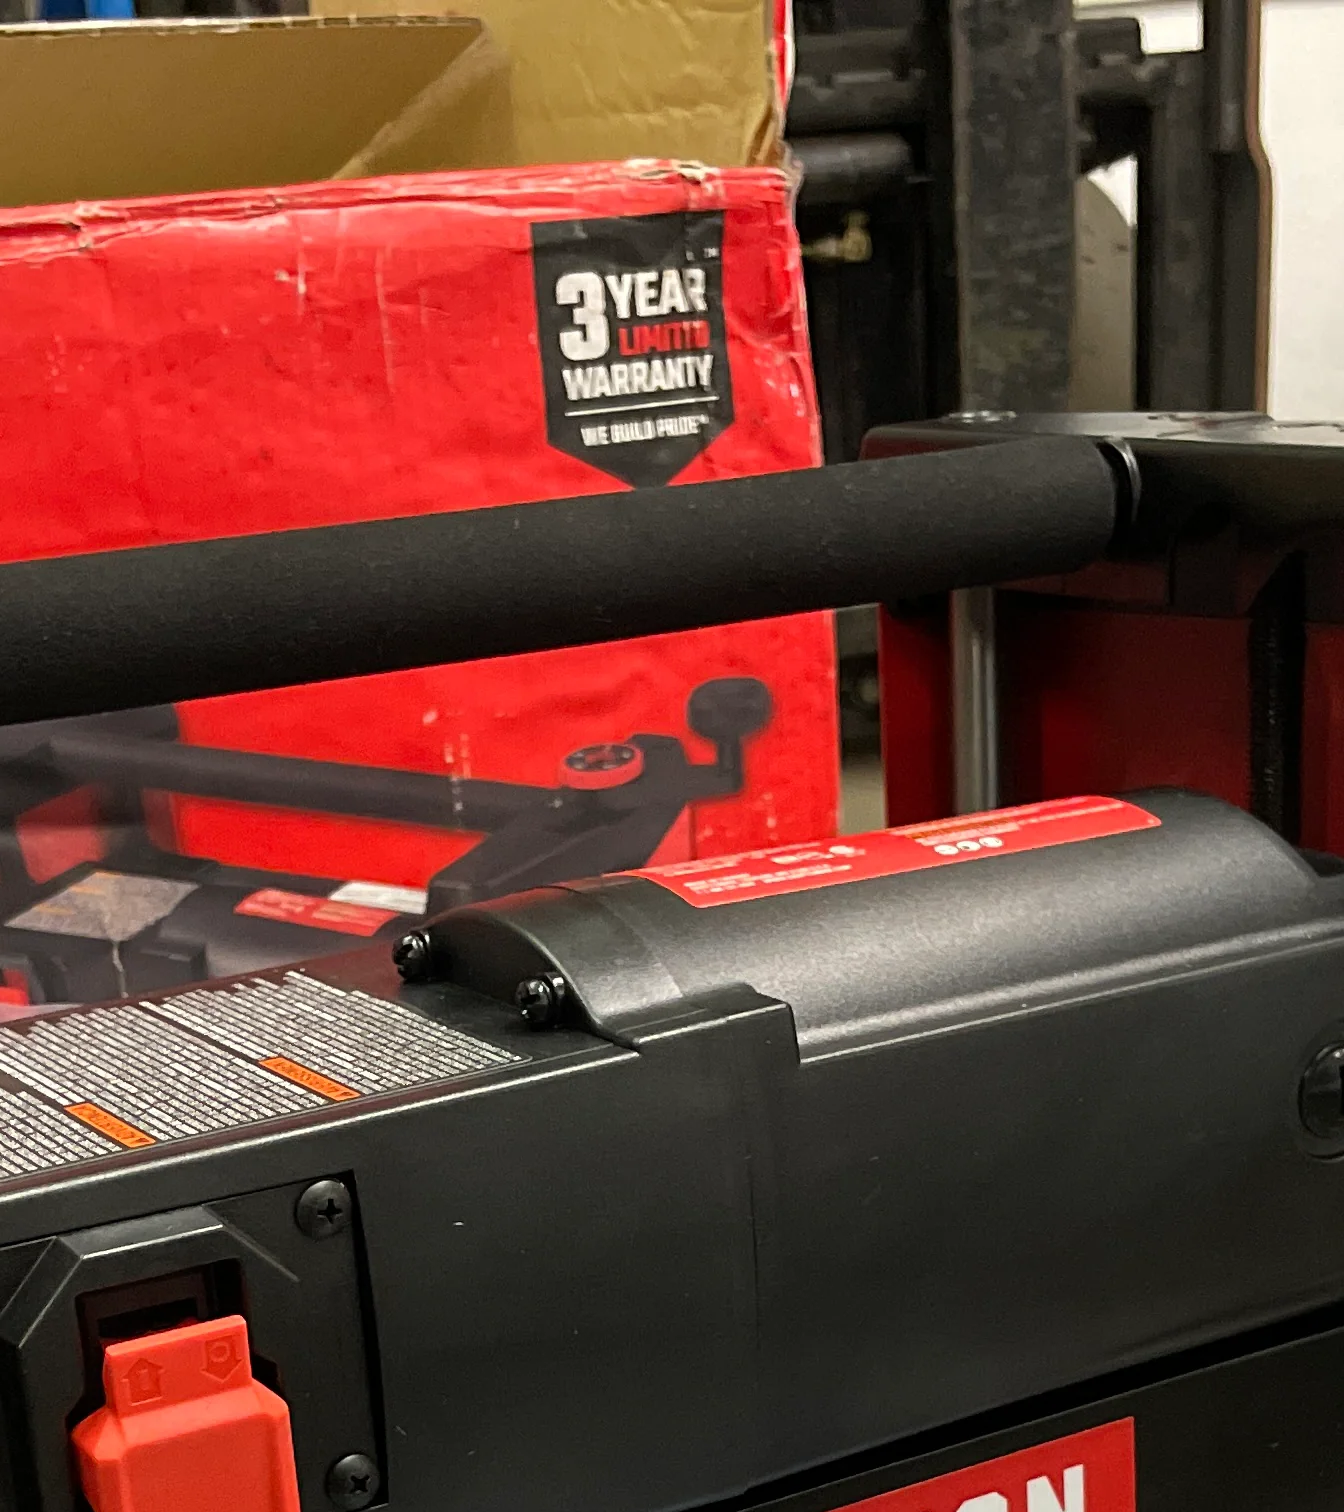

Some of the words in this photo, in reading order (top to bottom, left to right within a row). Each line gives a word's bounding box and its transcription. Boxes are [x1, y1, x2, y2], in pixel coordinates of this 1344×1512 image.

[556, 271, 610, 362] 3
[605, 267, 709, 320] YEAR
[561, 354, 715, 401] WARRANTY
[580, 425, 610, 447] WE
